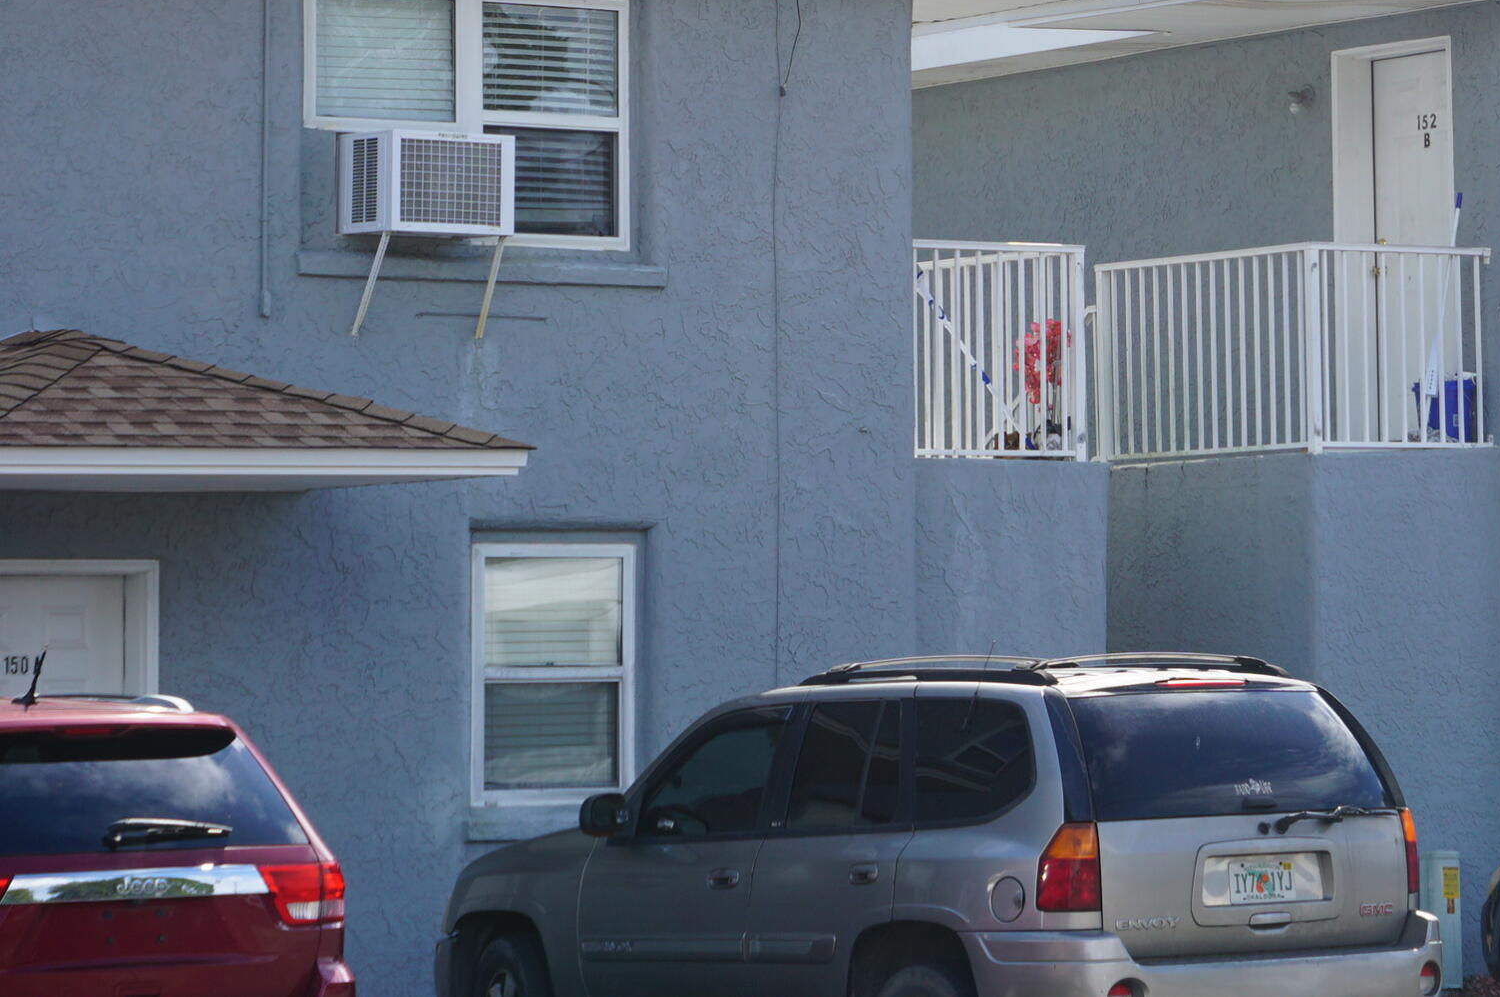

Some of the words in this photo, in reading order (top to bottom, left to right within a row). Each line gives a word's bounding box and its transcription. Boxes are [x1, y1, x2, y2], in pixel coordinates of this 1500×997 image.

[1417, 113, 1437, 131] 152
[1424, 132, 1431, 148] B
[4, 655, 29, 675] 150
[116, 875, 169, 898] Jeep
[1359, 902, 1393, 916] GMC
[1114, 916, 1182, 931] ENVOY
